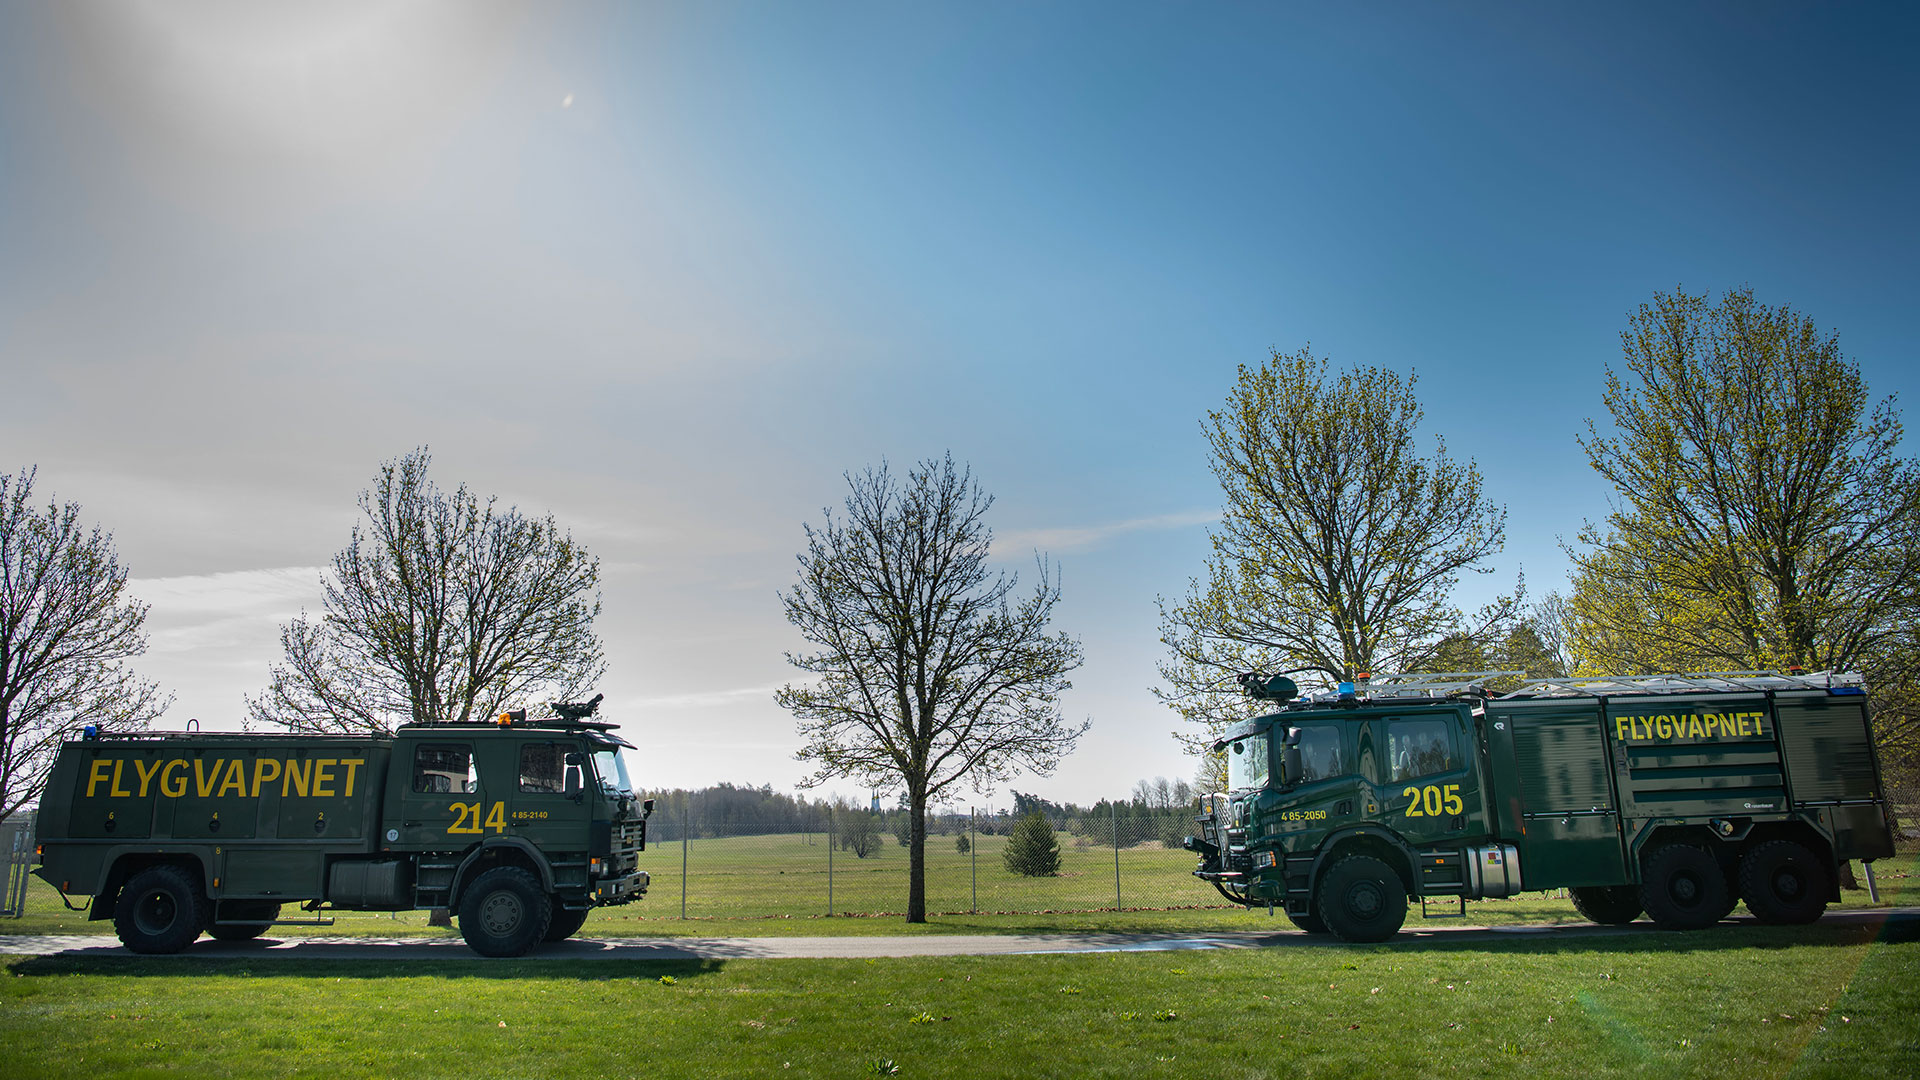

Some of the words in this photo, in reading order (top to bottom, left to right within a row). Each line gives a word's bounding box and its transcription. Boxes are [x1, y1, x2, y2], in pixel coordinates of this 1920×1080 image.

[1616, 712, 1764, 741] FLYGVAPNET
[86, 758, 365, 798] FLYGVAPNET
[1403, 784, 1463, 817] 205
[108, 811, 115, 820] 6
[212, 811, 218, 820] 4
[318, 811, 324, 820] 2
[447, 801, 507, 835] 214
[512, 811, 517, 819] 4
[518, 811, 548, 819] 85-2140
[1281, 812, 1288, 821] 4
[1289, 809, 1327, 821] 85-2050
[215, 846, 221, 855] 8
